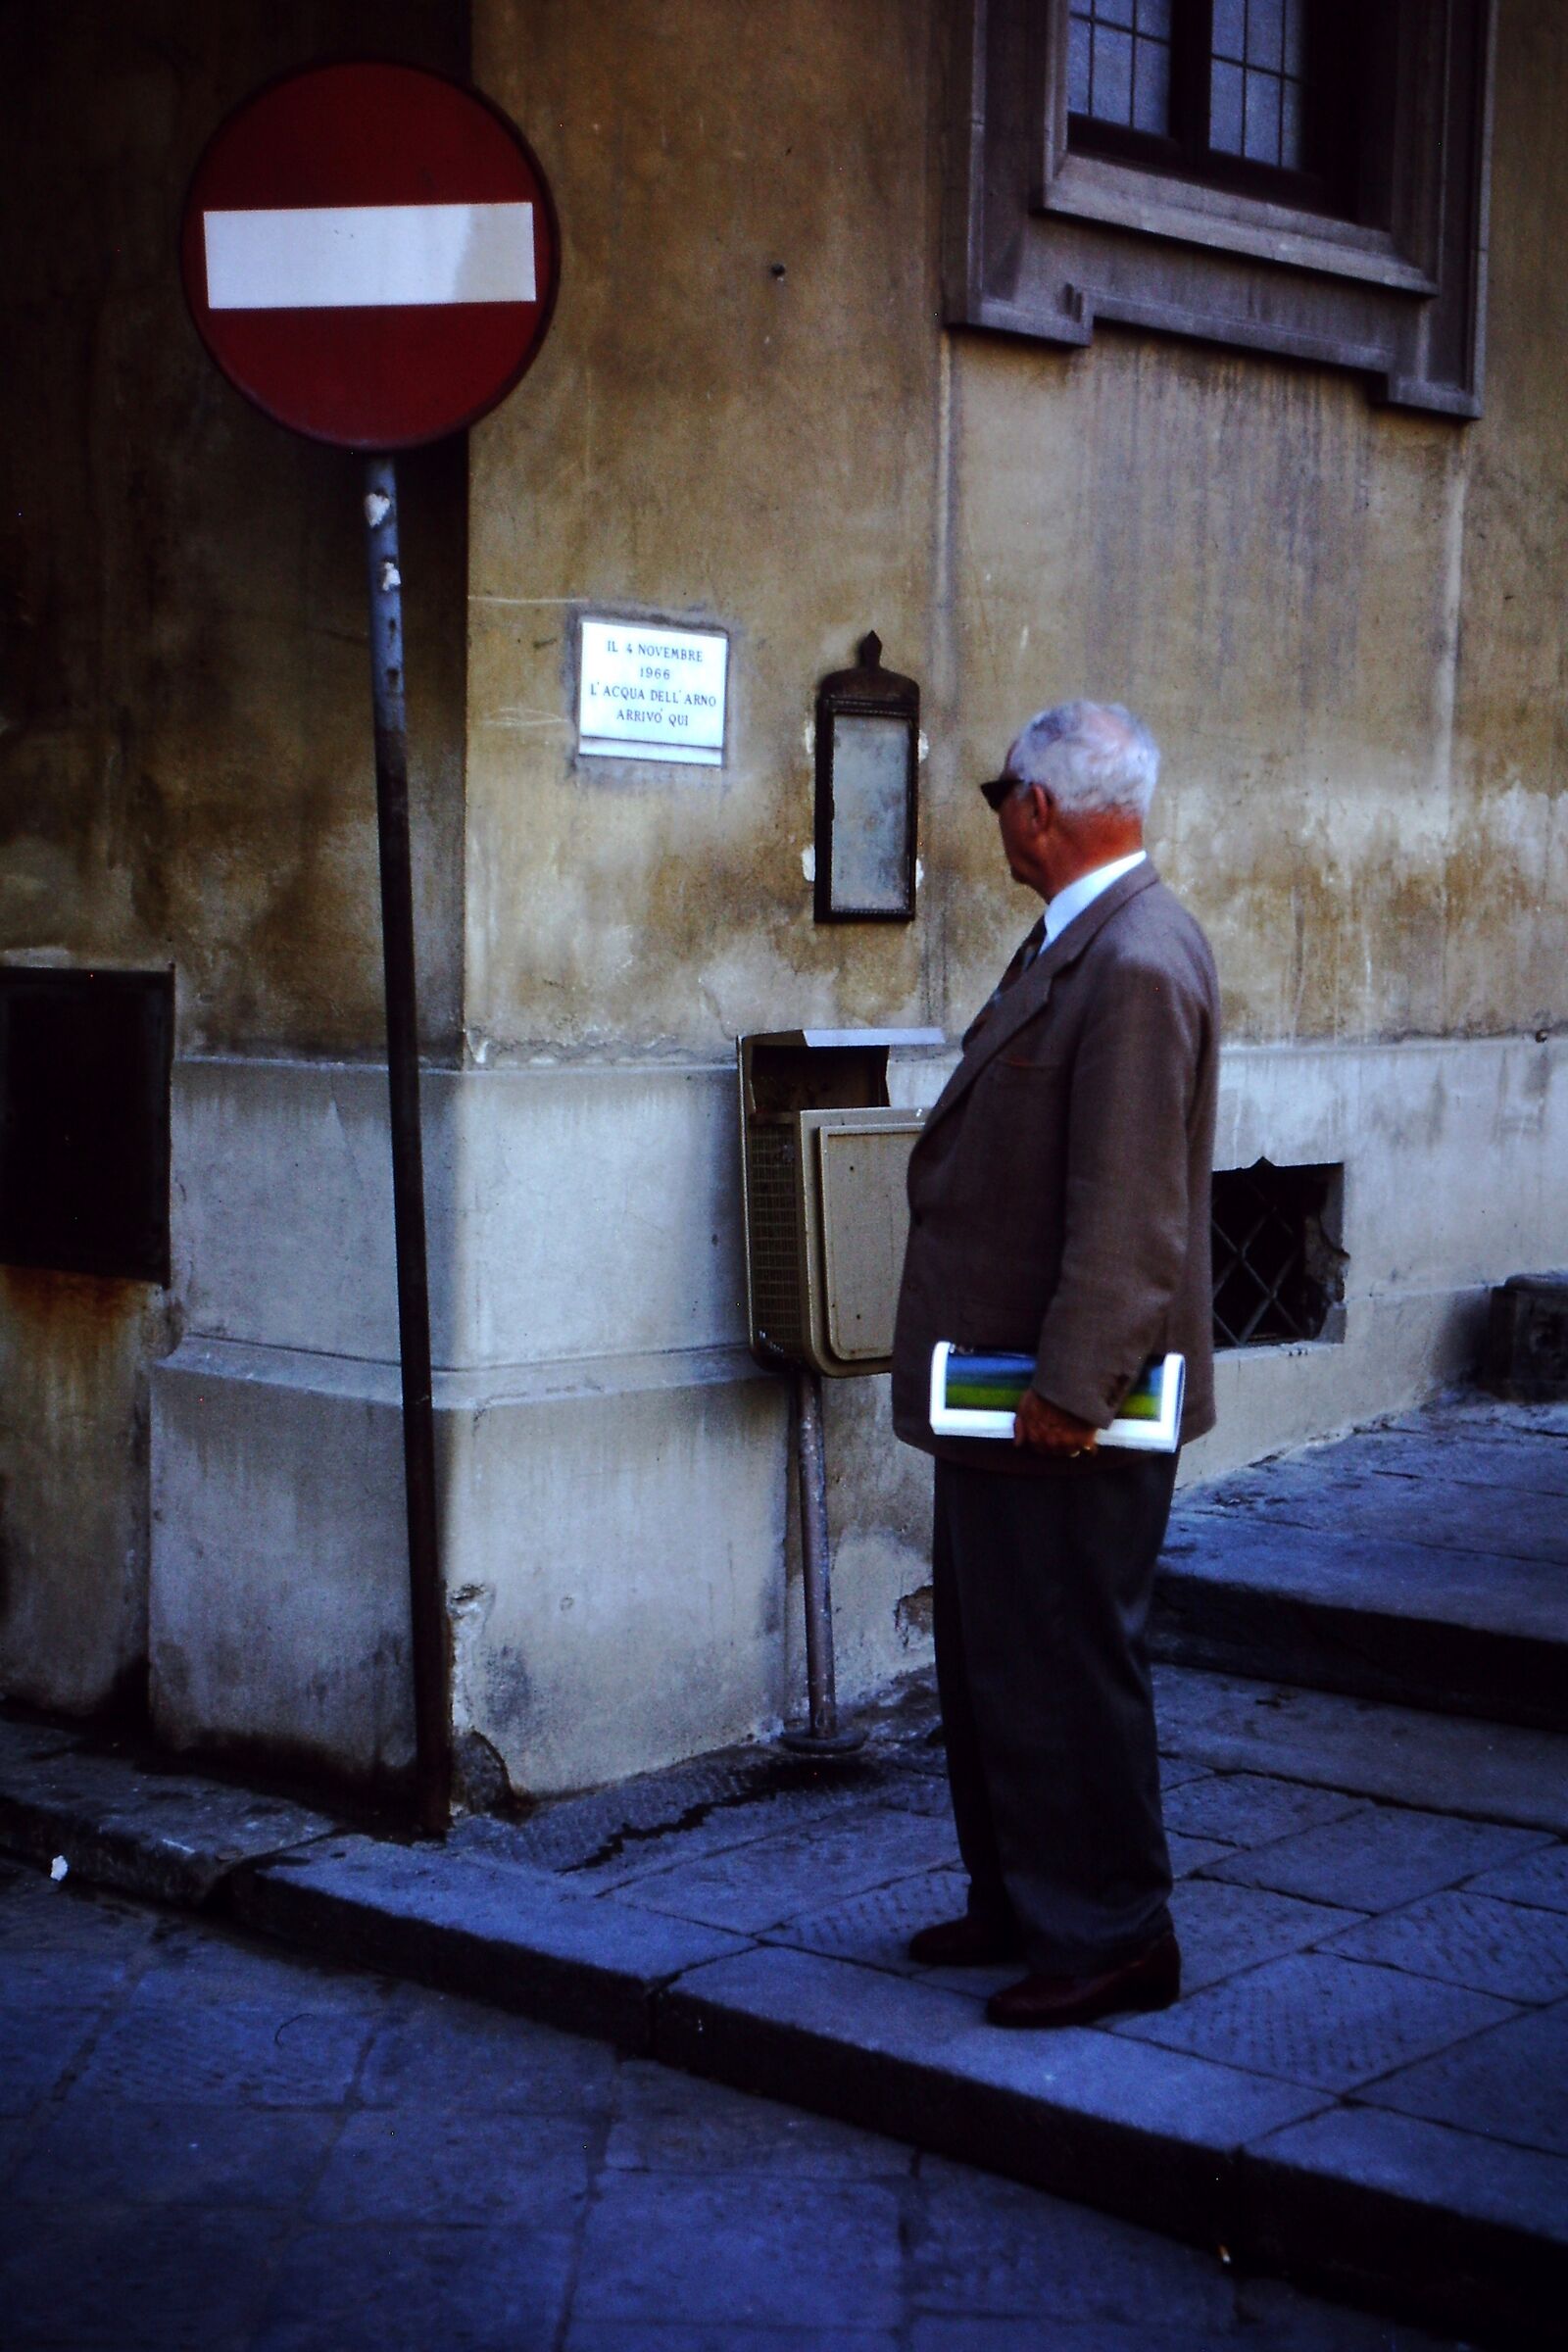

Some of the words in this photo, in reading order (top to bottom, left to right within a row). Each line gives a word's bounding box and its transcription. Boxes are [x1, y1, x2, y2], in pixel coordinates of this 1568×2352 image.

[607, 640, 618, 653] IL
[626, 643, 633, 654] 4
[638, 644, 703, 662] NOVEMBRE
[640, 666, 670, 680] 1966
[668, 713, 689, 727] QUI
